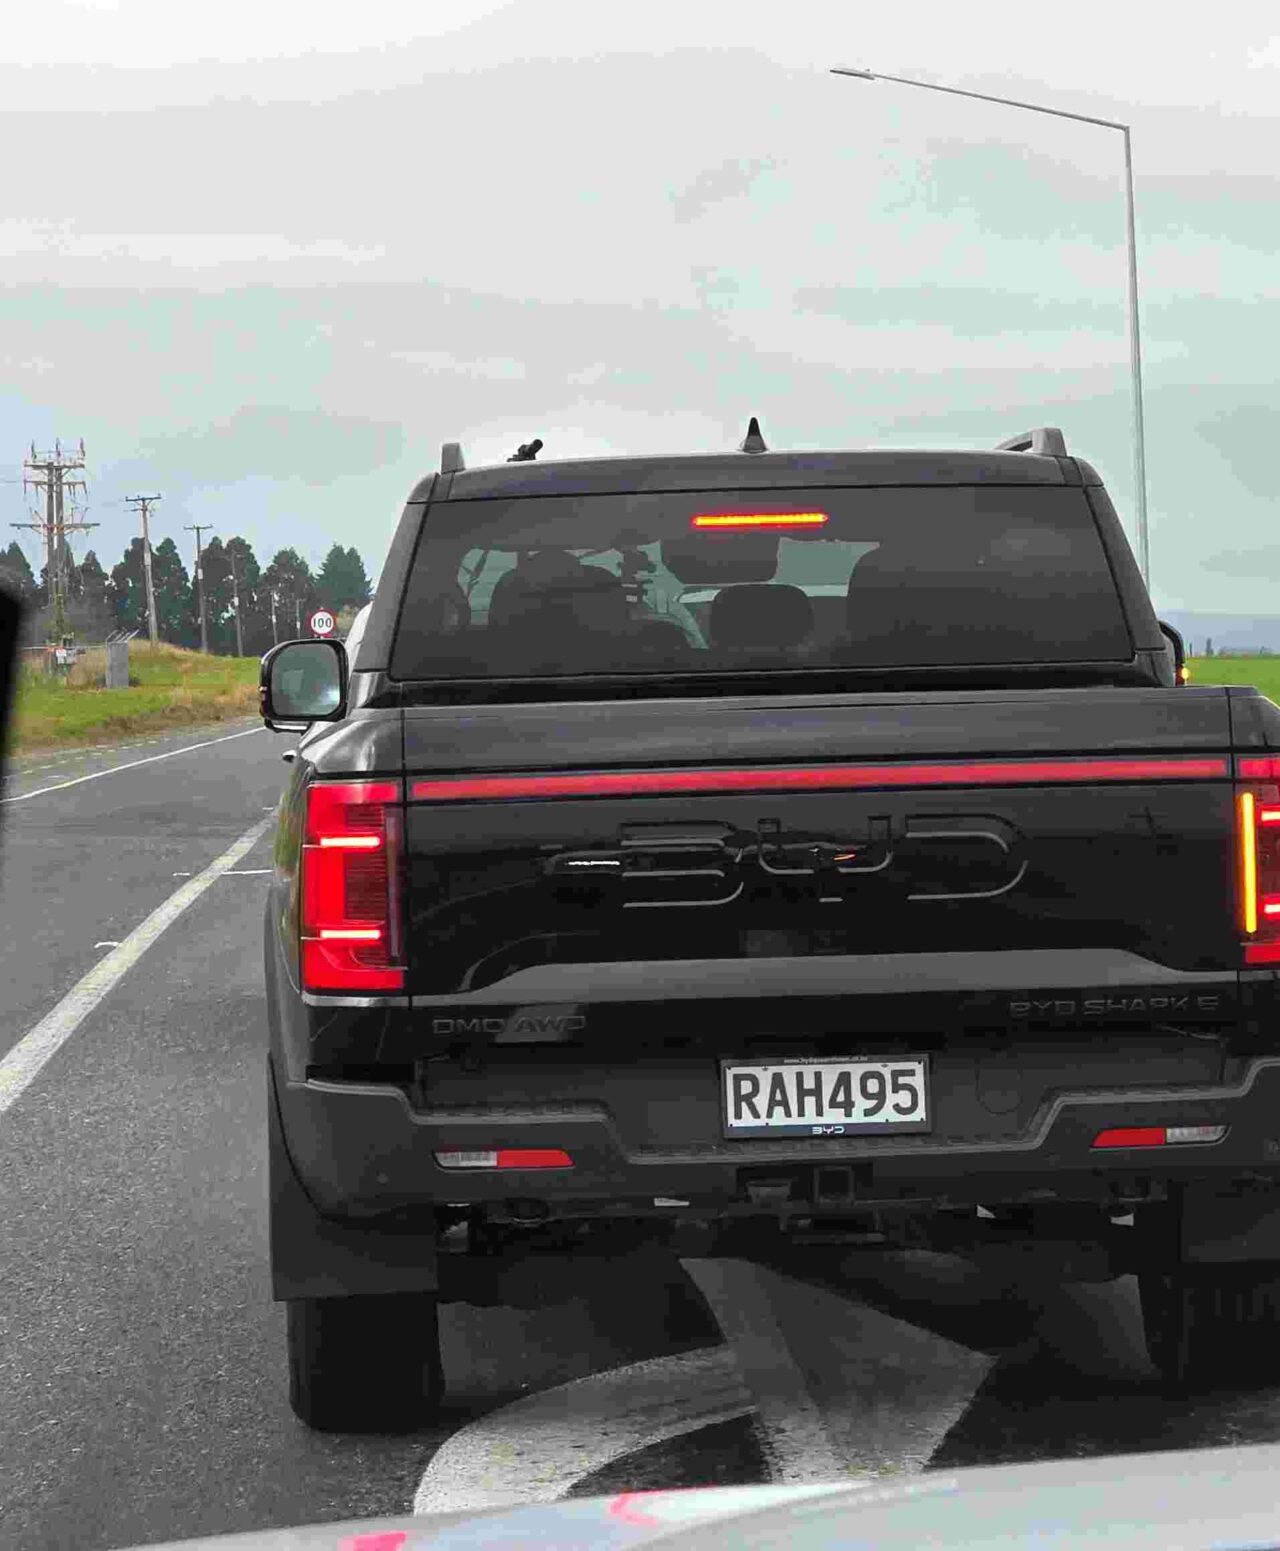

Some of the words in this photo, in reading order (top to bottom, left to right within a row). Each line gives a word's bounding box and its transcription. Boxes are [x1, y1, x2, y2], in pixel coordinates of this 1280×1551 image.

[313, 617, 332, 628] 100
[621, 814, 1028, 908] BYD
[732, 1069, 919, 1120] RAH495
[811, 1126, 845, 1135] BYD
